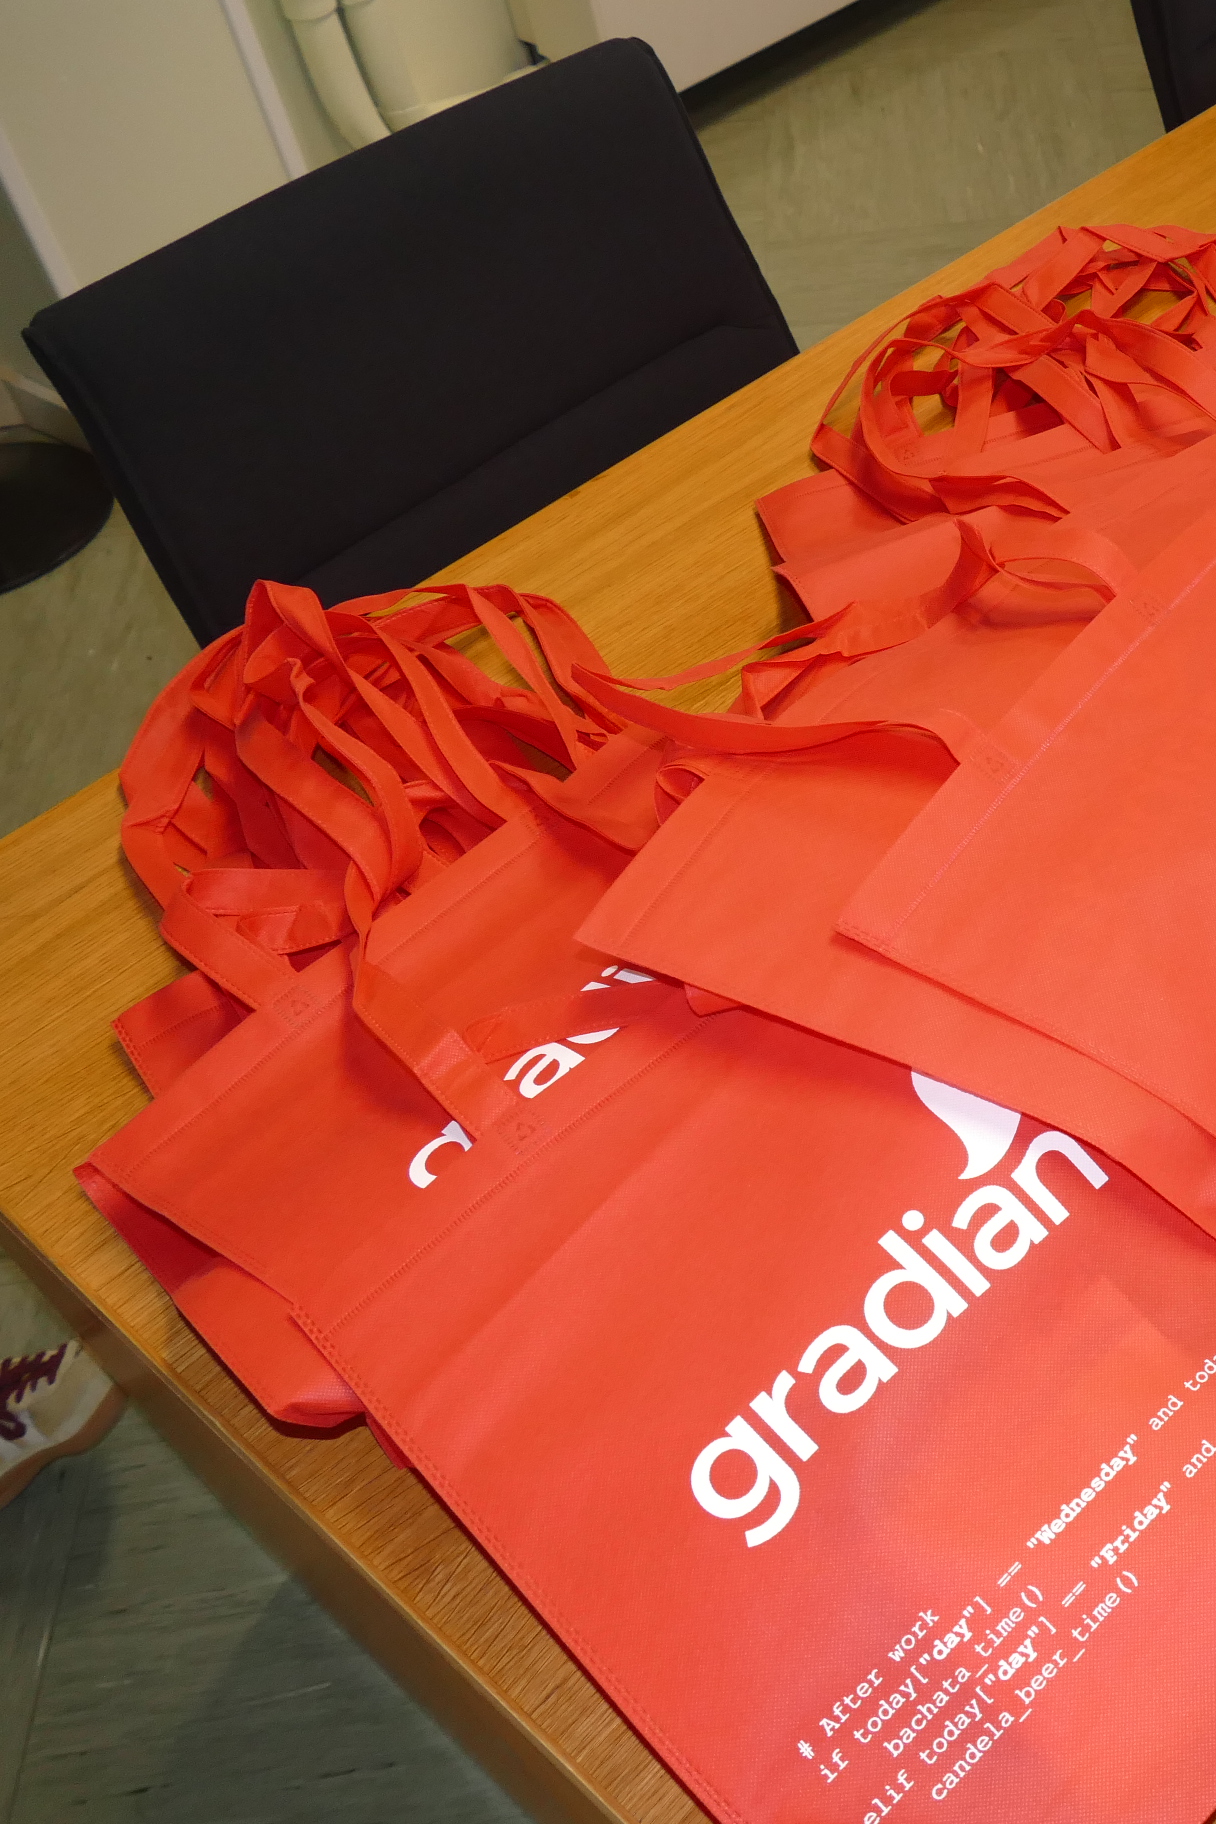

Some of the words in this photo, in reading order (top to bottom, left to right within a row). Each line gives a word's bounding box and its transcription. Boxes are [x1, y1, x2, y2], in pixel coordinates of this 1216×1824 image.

[690, 1130, 1109, 1548] gradian
[797, 1739, 816, 1760] #
[818, 1668, 884, 1738] After
[887, 1609, 940, 1662] work
[819, 1748, 850, 1784] if
[996, 1561, 1023, 1588] ==
[1148, 1394, 1184, 1431] and
[863, 1768, 915, 1824] elif
[1061, 1580, 1087, 1608] ==
[1089, 1480, 1172, 1568] "Friday"
